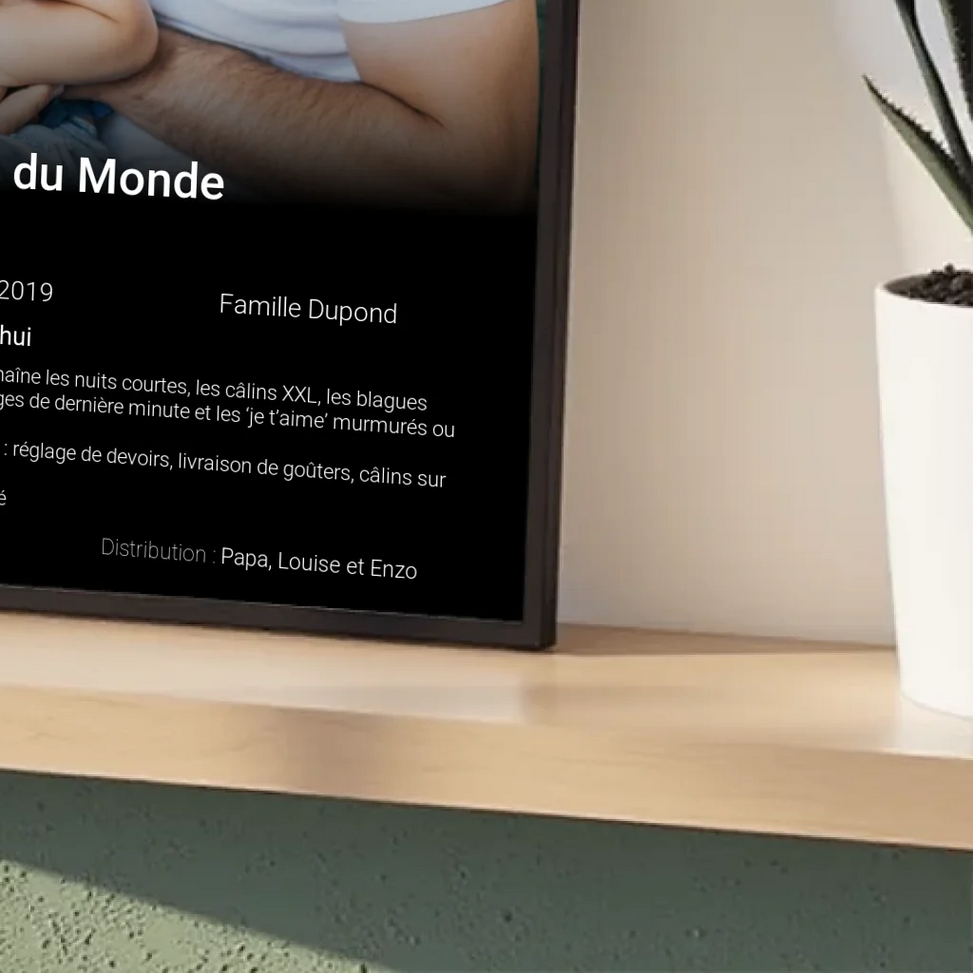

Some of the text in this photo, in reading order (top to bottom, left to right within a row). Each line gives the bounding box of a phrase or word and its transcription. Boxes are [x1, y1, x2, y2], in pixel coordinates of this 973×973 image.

[14, 153, 63, 191] du
[79, 157, 224, 200] Monde
[220, 293, 397, 326] Famille Dupond
[46, 369, 70, 387] les
[75, 372, 117, 390] nuits
[122, 378, 191, 397] courtes,
[196, 379, 220, 397] les
[225, 382, 277, 401] câlins
[282, 385, 321, 406] XXL,
[327, 388, 351, 406] les
[357, 390, 427, 413] blagues
[29, 393, 50, 409] de
[54, 394, 124, 415] dernière
[129, 400, 190, 419] minute
[195, 405, 211, 421] et
[216, 405, 241, 423] les
[333, 417, 427, 436] murmurés
[432, 424, 455, 438] ou
[13, 441, 76, 465] réglage
[81, 446, 102, 463] de
[106, 447, 173, 471] devoirs,
[178, 452, 251, 474] livraison
[257, 458, 279, 476] de
[283, 461, 354, 484] goûters,
[359, 466, 412, 486] câlins
[417, 473, 447, 488] sur
[102, 537, 206, 563] Distribution
[221, 547, 272, 571] Papa,
[278, 551, 341, 574] Louise
[346, 558, 365, 576] et
[371, 559, 417, 580] Enzo
